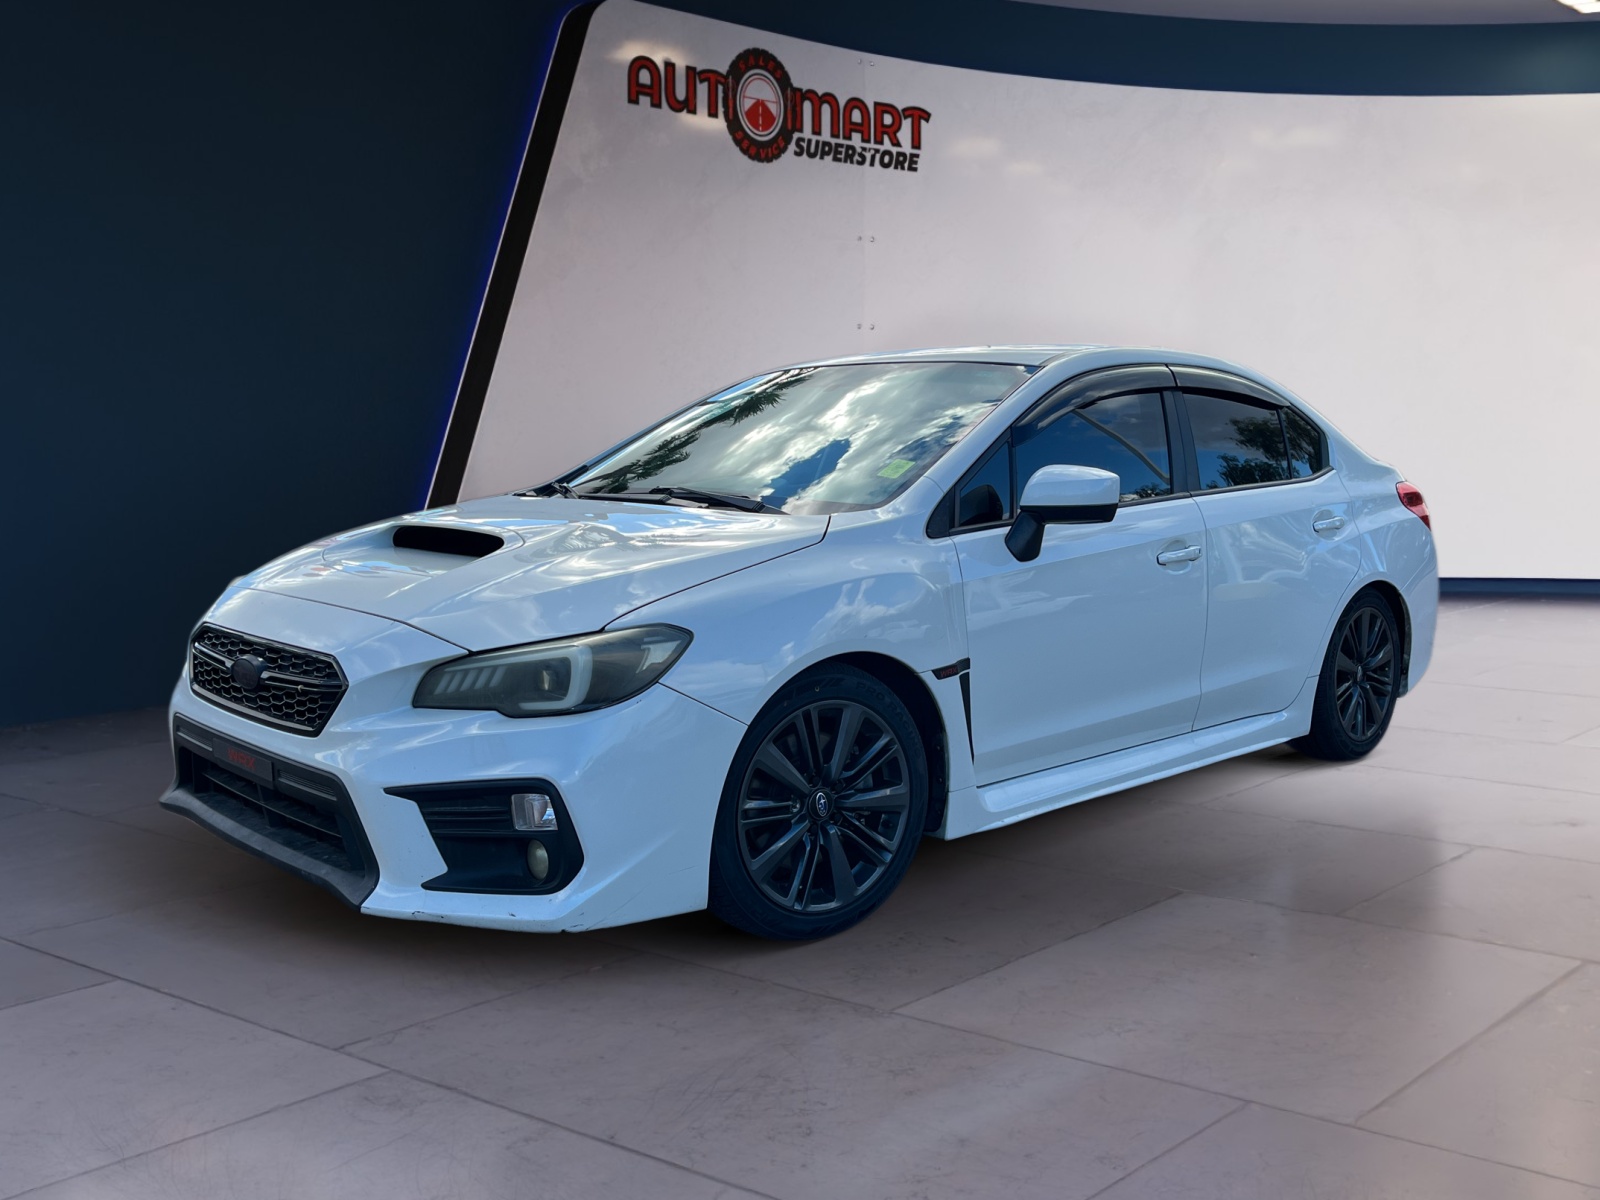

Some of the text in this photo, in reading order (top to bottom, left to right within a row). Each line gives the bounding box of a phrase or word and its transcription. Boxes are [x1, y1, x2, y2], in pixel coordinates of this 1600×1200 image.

[739, 55, 784, 78] SALES
[734, 131, 785, 159] SERVICE
[793, 137, 921, 172] SUPERSTORE
[940, 667, 958, 677] WRX
[228, 747, 256, 770] WRX
